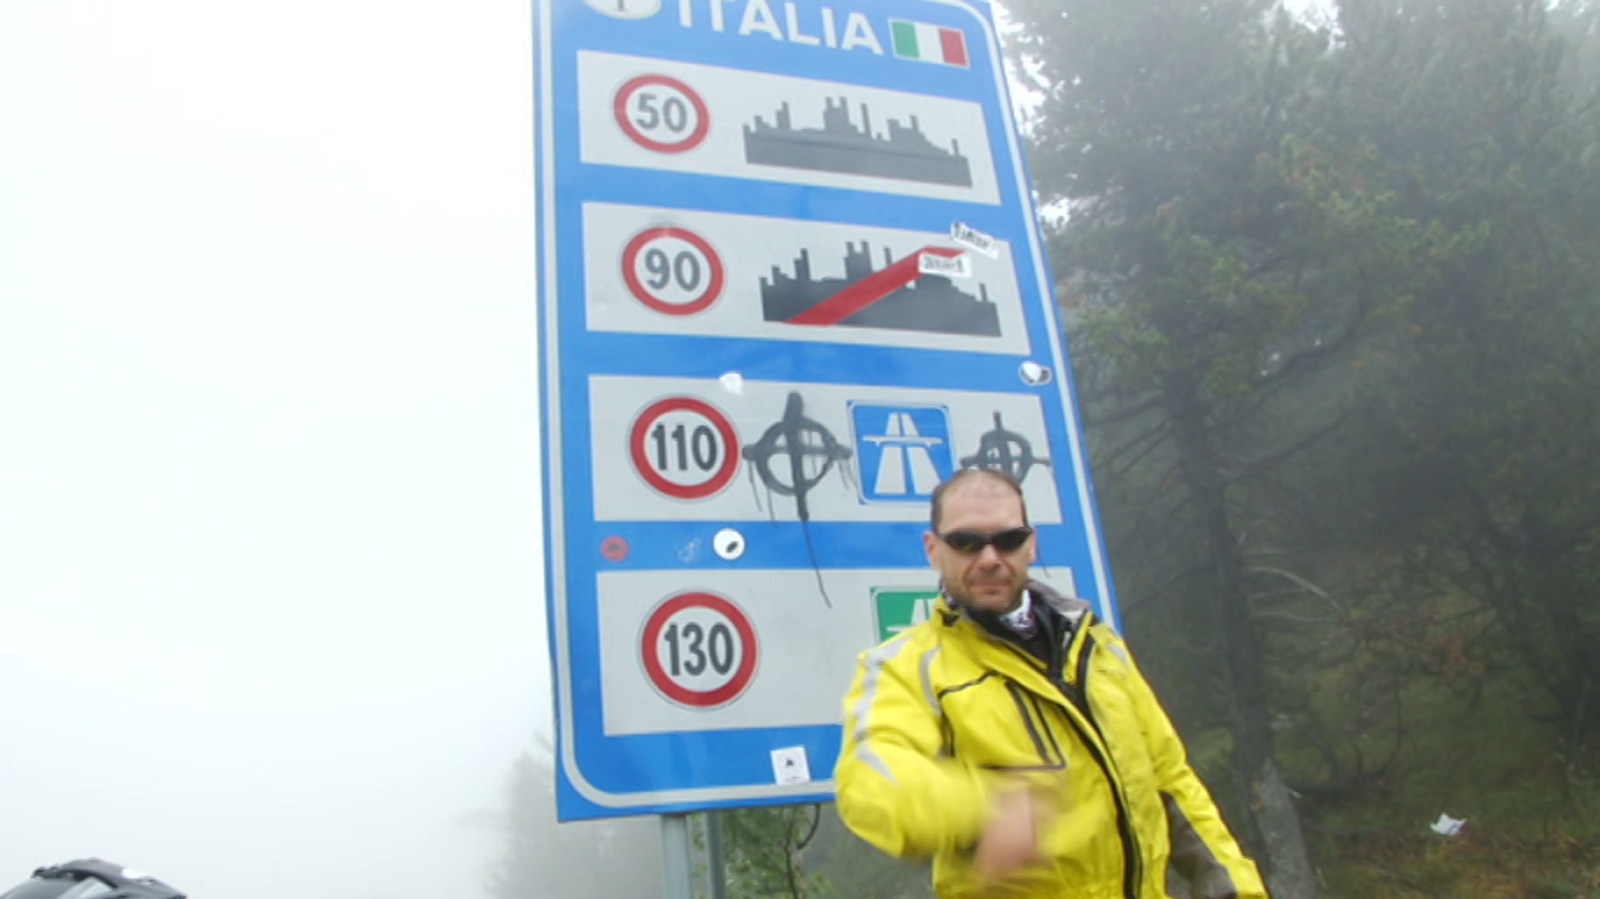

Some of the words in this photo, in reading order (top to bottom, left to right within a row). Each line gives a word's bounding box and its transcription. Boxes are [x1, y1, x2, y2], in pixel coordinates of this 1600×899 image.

[677, 0, 885, 56] ITALIA
[636, 92, 688, 134] 50
[644, 247, 701, 293] 90
[651, 423, 718, 472] 110
[664, 621, 735, 677] 130
